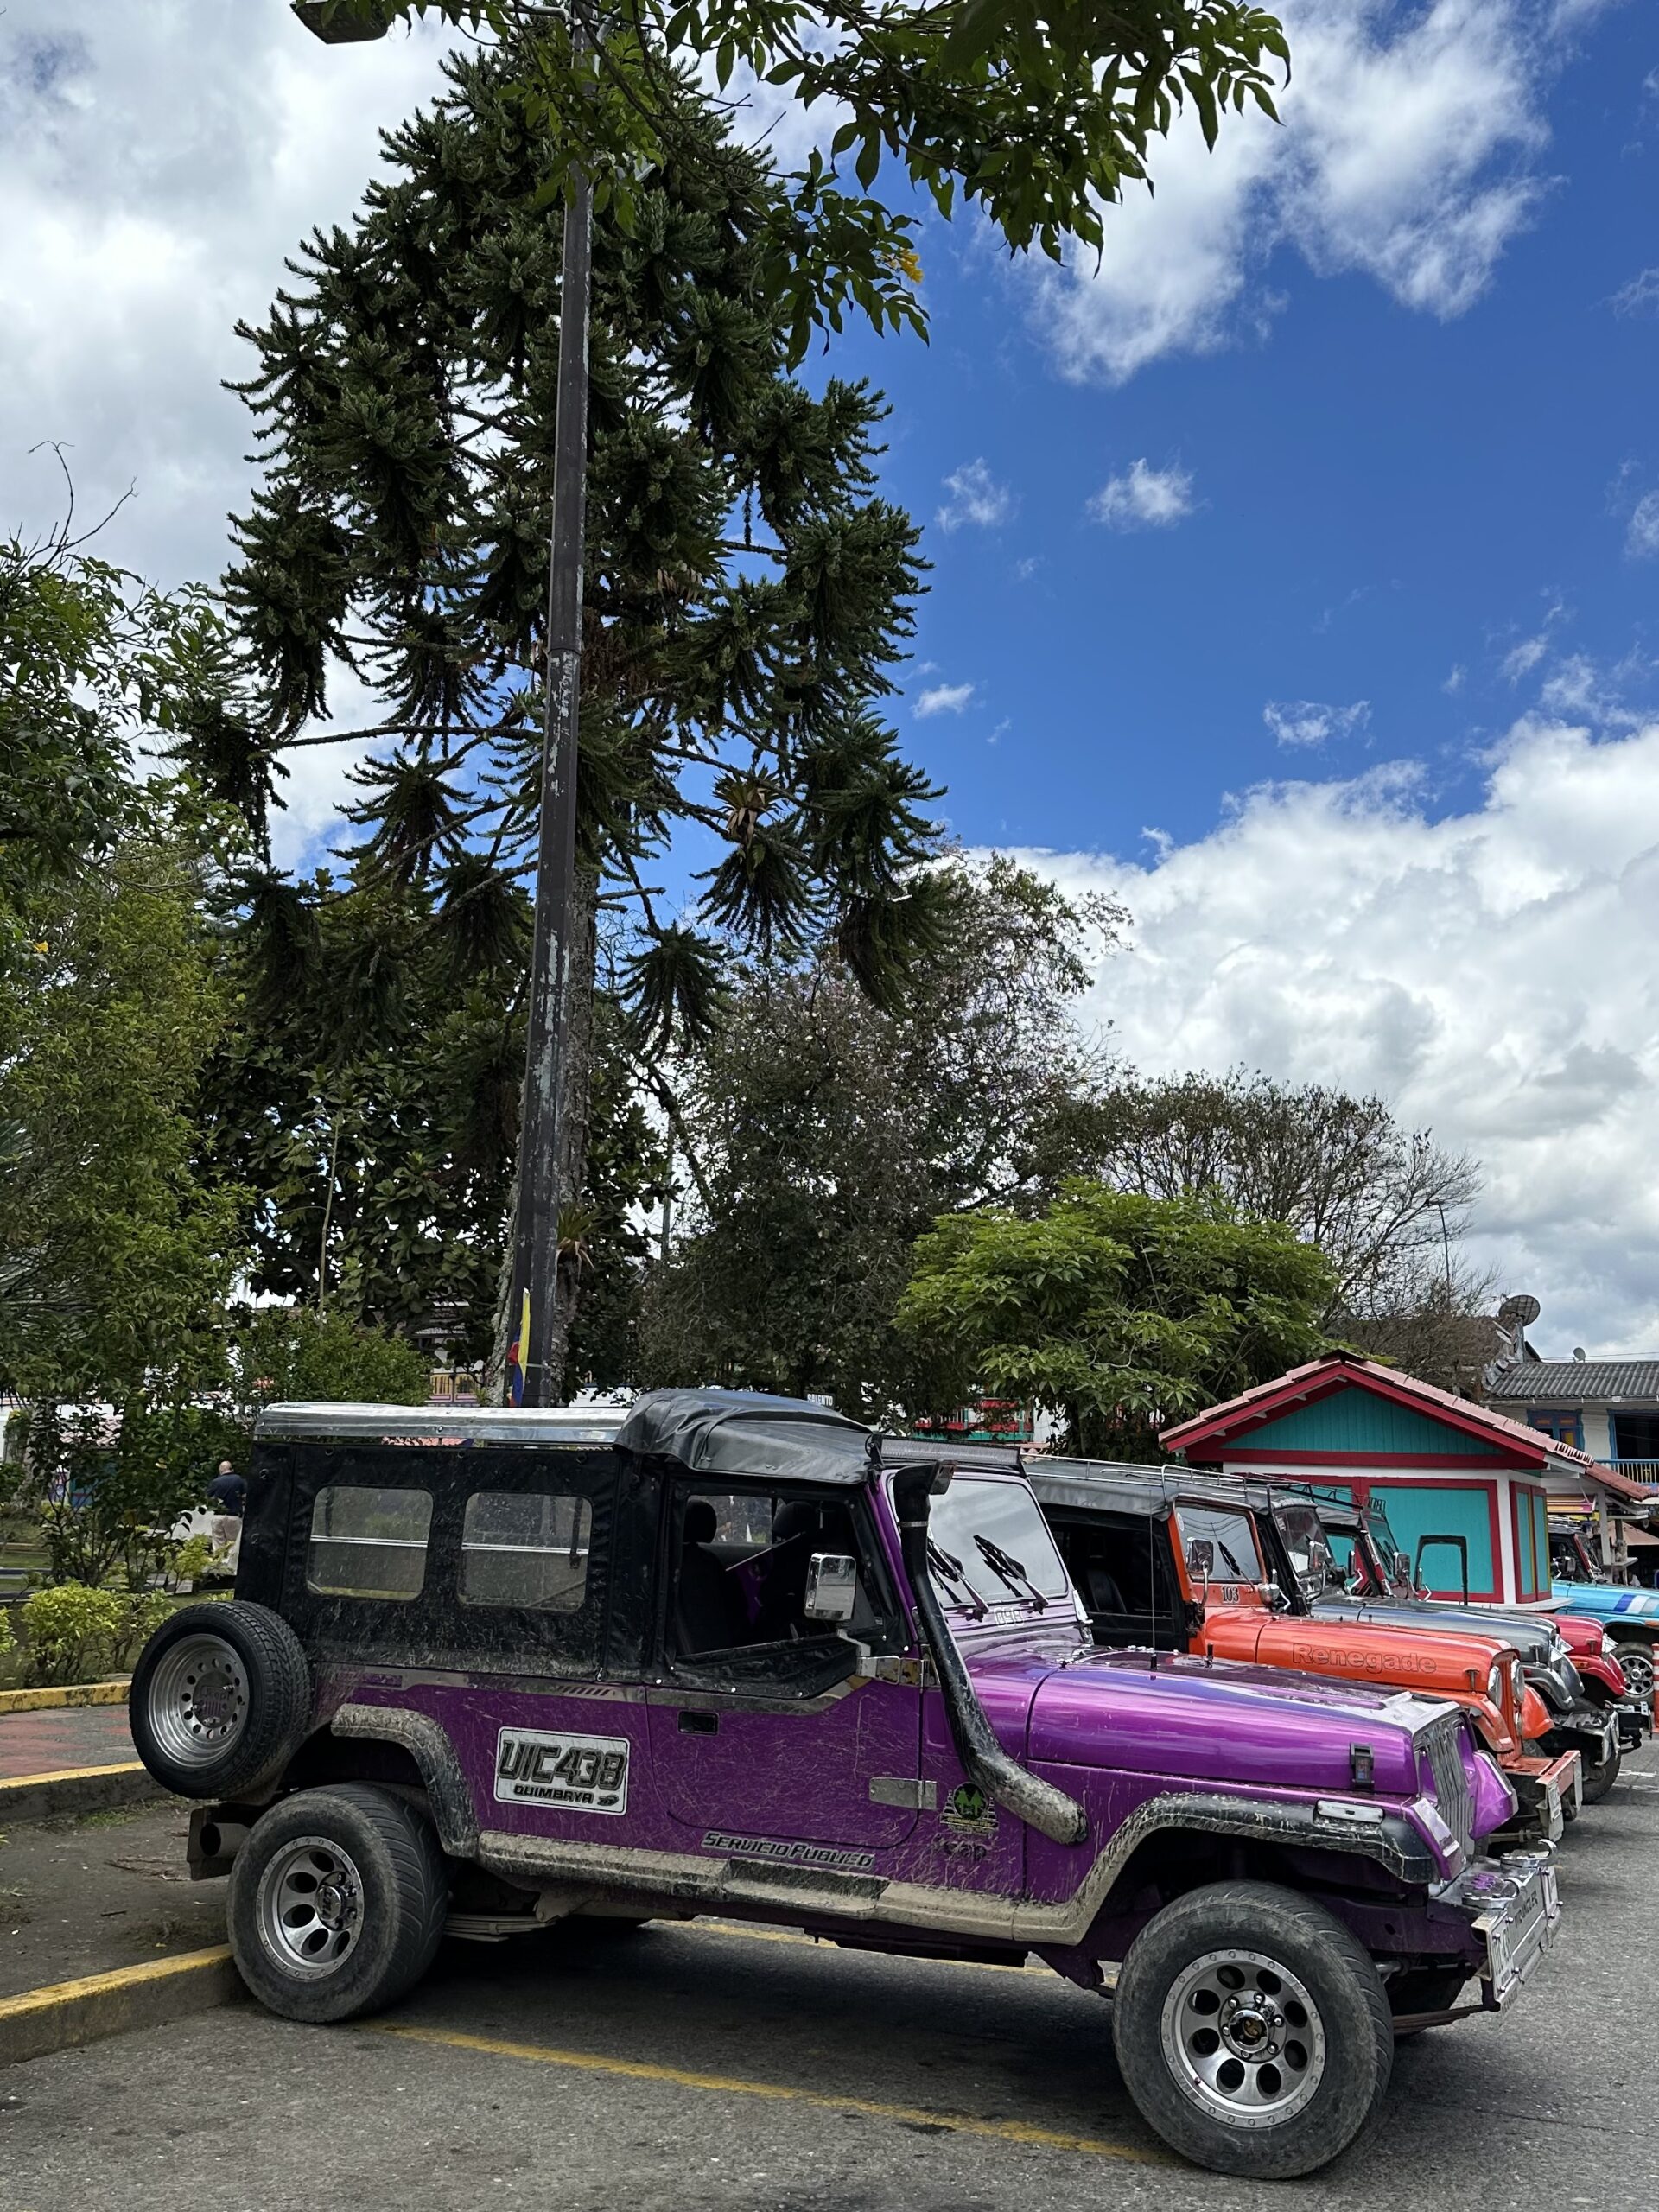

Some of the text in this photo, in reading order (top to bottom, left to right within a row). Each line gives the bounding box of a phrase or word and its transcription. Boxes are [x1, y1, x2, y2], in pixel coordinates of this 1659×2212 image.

[1222, 1586, 1239, 1603] 103
[1293, 1643, 1437, 1674] Renegade
[498, 1740, 627, 1791] UIC438
[513, 1783, 594, 1804] QUIMBAYA
[702, 1832, 790, 1857] SERVICIO
